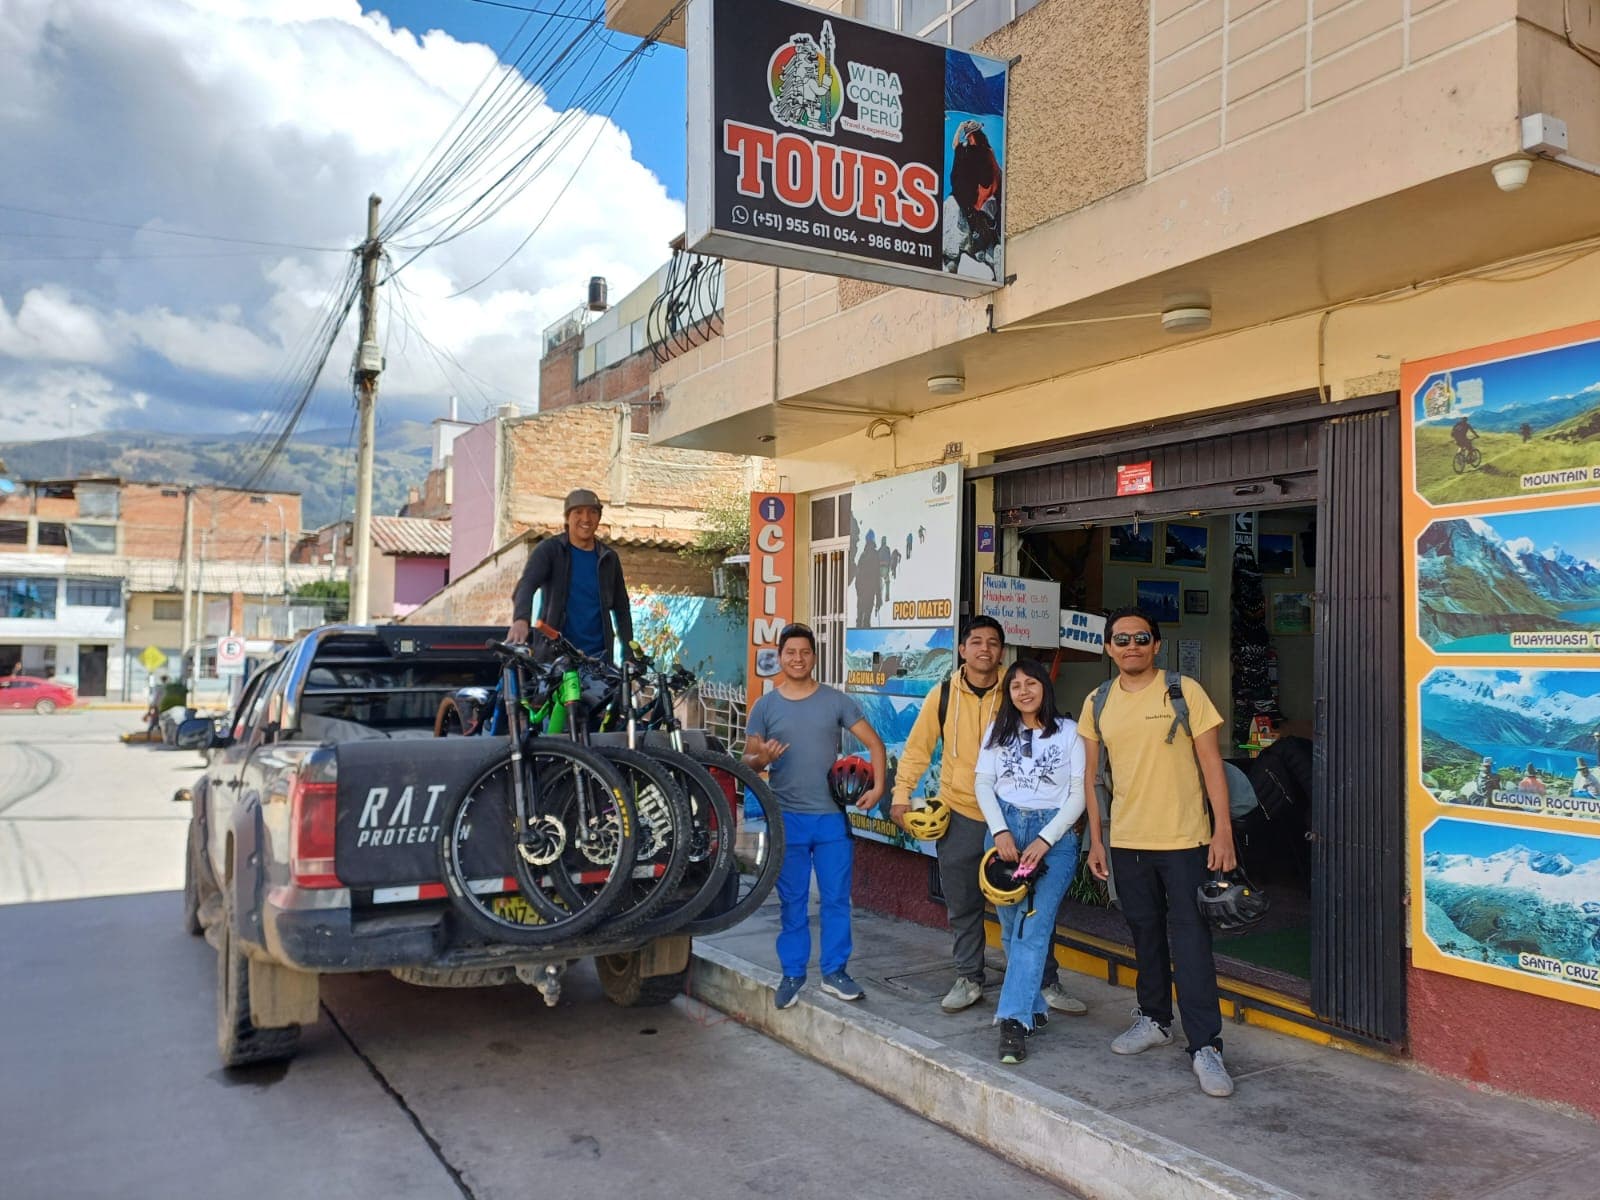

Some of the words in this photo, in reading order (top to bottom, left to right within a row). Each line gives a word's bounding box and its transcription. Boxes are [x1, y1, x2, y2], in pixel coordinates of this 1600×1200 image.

[850, 65, 899, 91] WIRA
[849, 85, 900, 110] COCHA
[860, 106, 899, 128] PERÚ
[725, 121, 937, 232] TOURS
[753, 209, 782, 231] (+51)
[786, 217, 810, 234] 955
[812, 223, 830, 238] 611
[834, 227, 857, 243] 054
[868, 234, 891, 250] 986
[894, 239, 916, 255] 802
[918, 244, 932, 258] 111
[1523, 469, 1588, 487] MOUNTAIN
[893, 601, 916, 620] PICO
[917, 599, 951, 619] MATEO
[1072, 614, 1087, 627] EN
[1060, 627, 1103, 646] OFERTA
[1513, 634, 1588, 646] HUAYHUASH
[227, 642, 237, 655] E
[848, 671, 874, 686] LAGUNA
[358, 784, 447, 828] RAT
[1495, 792, 1542, 807] LAGUNA
[848, 812, 871, 831] GUNA
[357, 824, 472, 848] PROTECTN
[1521, 955, 1562, 973] SANTA
[1566, 964, 1599, 981] CRUZ
